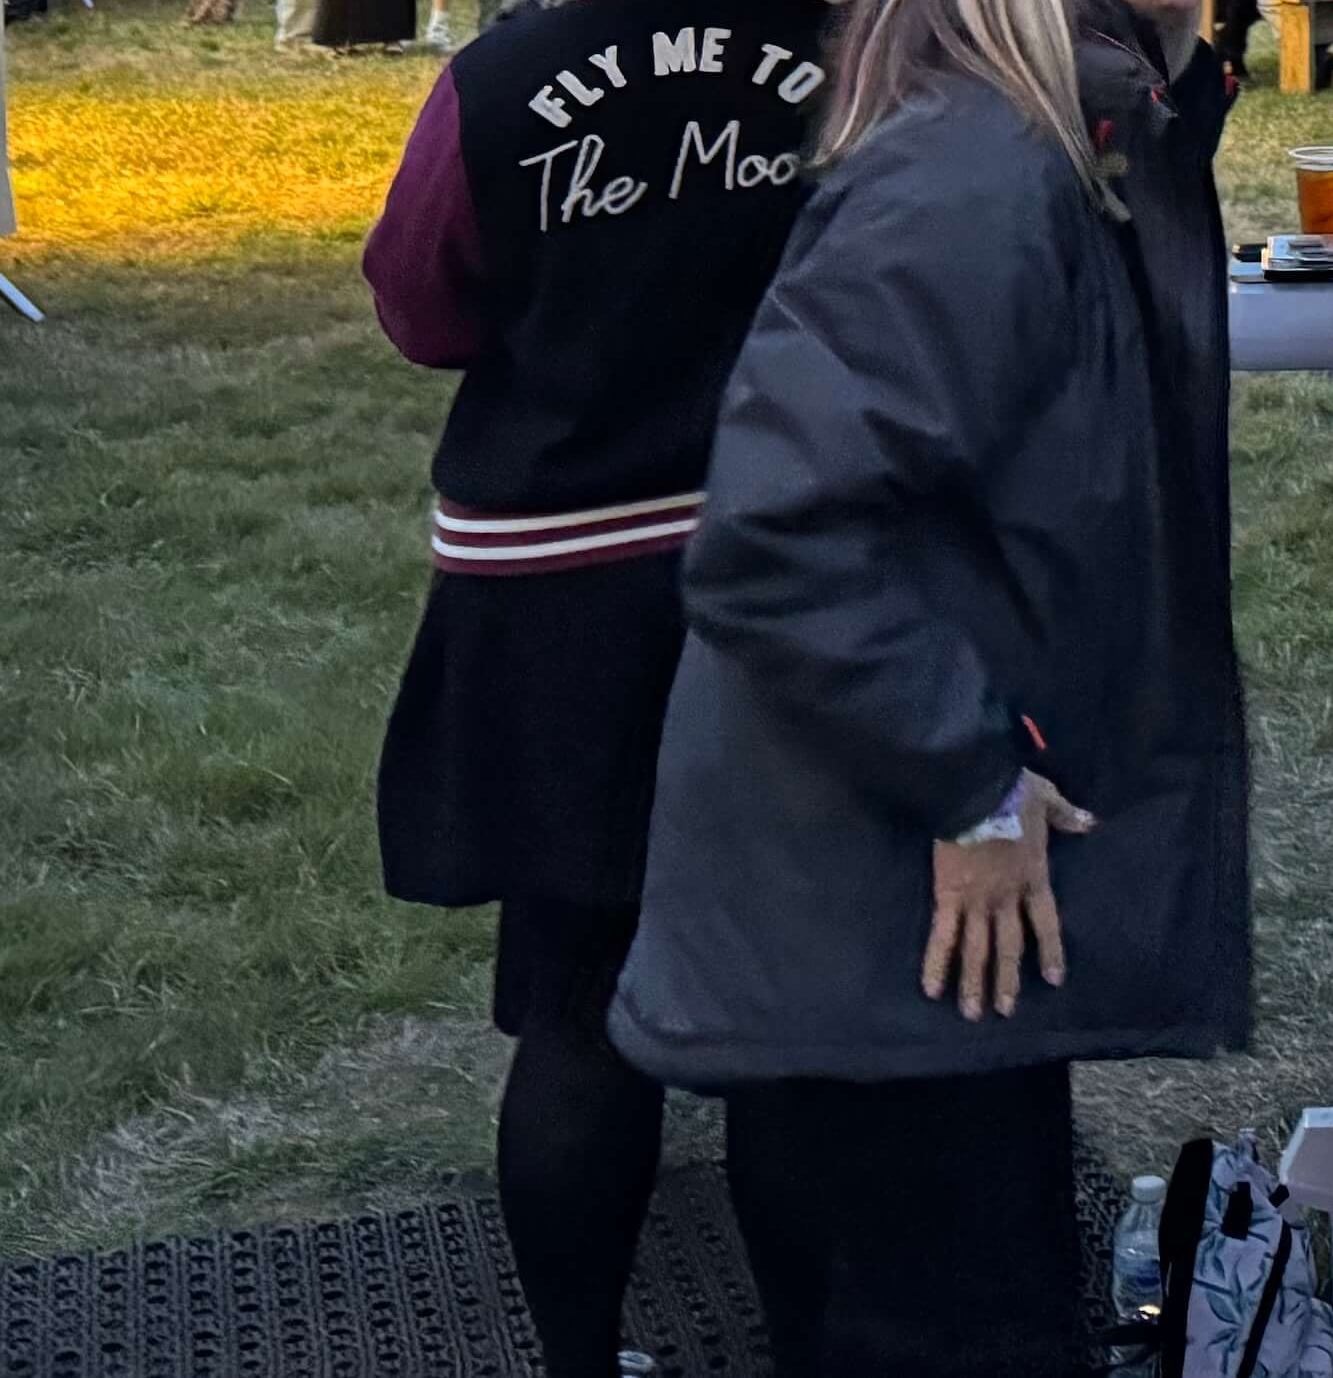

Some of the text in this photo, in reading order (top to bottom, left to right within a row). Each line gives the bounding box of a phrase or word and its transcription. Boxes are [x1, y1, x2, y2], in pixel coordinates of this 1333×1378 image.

[527, 26, 827, 128] FLY ME TO
[518, 119, 800, 233] The Moo
